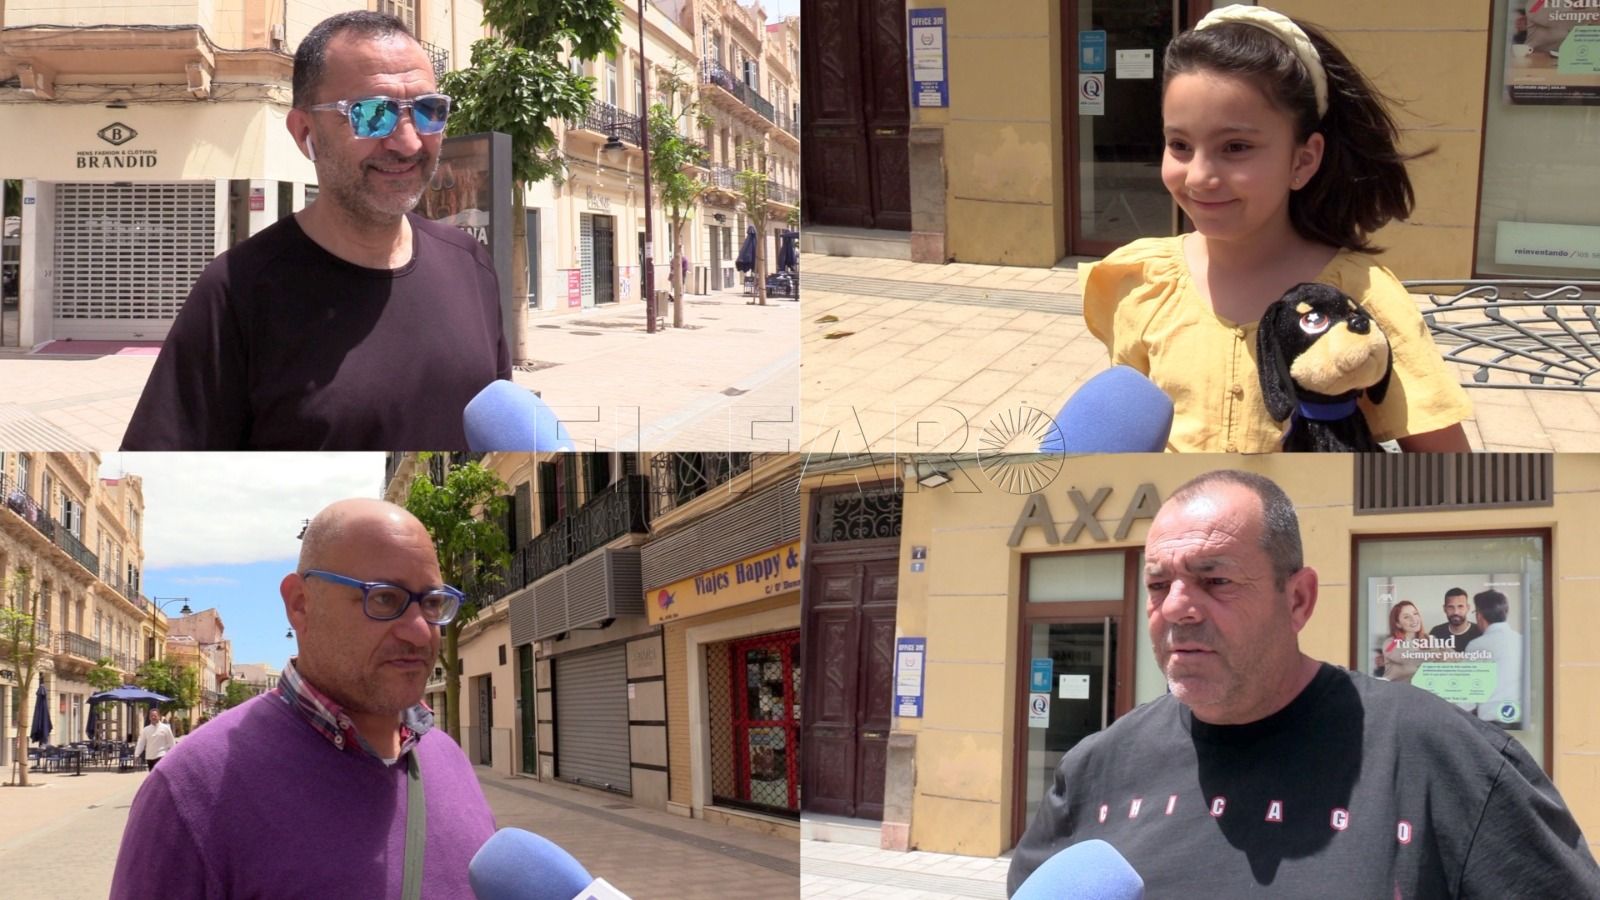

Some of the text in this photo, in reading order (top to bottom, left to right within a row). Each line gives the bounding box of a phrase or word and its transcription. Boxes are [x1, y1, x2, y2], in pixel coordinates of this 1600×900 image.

[911, 17, 932, 25] OFFICE
[1549, 10, 1600, 23] siempre
[112, 128, 122, 140] B
[76, 155, 157, 169] BRANDID
[1514, 247, 1569, 257] reinventando
[1006, 482, 1163, 547] AXA
[694, 571, 729, 596] Viajes
[735, 553, 780, 585] Happy
[786, 546, 799, 569] &
[1394, 634, 1456, 649] Tu salud
[1401, 649, 1493, 661] siempre protegida
